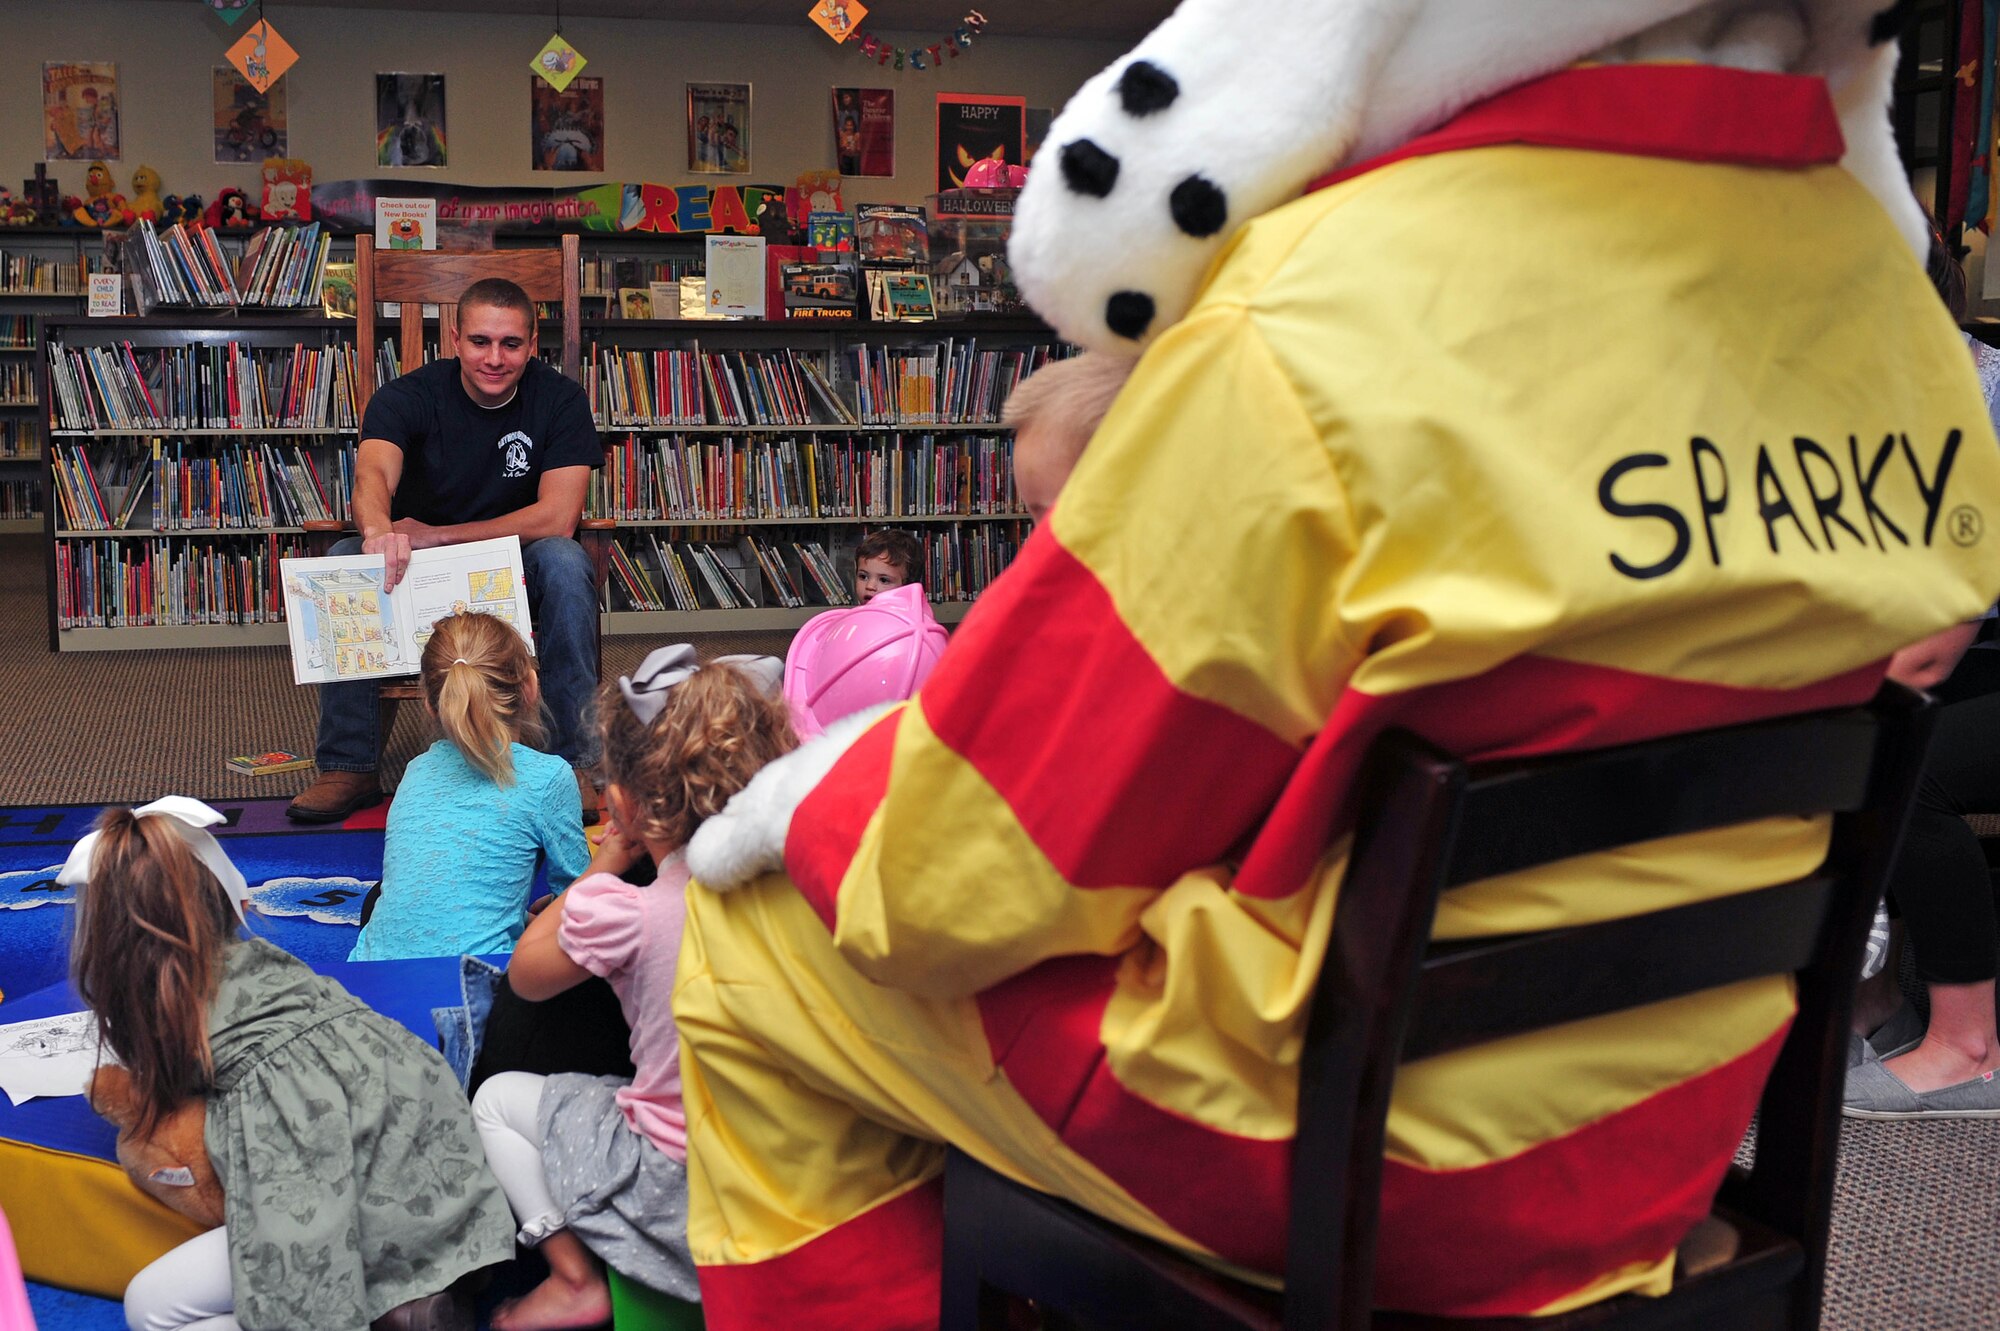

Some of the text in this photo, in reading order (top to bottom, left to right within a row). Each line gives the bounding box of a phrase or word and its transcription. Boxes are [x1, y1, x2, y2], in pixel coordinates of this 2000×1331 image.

[961, 105, 1000, 120] HAPPY
[380, 201, 403, 209] Check
[439, 196, 601, 228] of your imagination.
[943, 199, 1015, 214] HALLOWEEN
[93, 278, 116, 286] EVERY
[793, 309, 814, 318] FIRE
[817, 309, 852, 317] TRUCKS
[1597, 428, 1962, 581] SPARKY
[297, 889, 361, 907] 5
